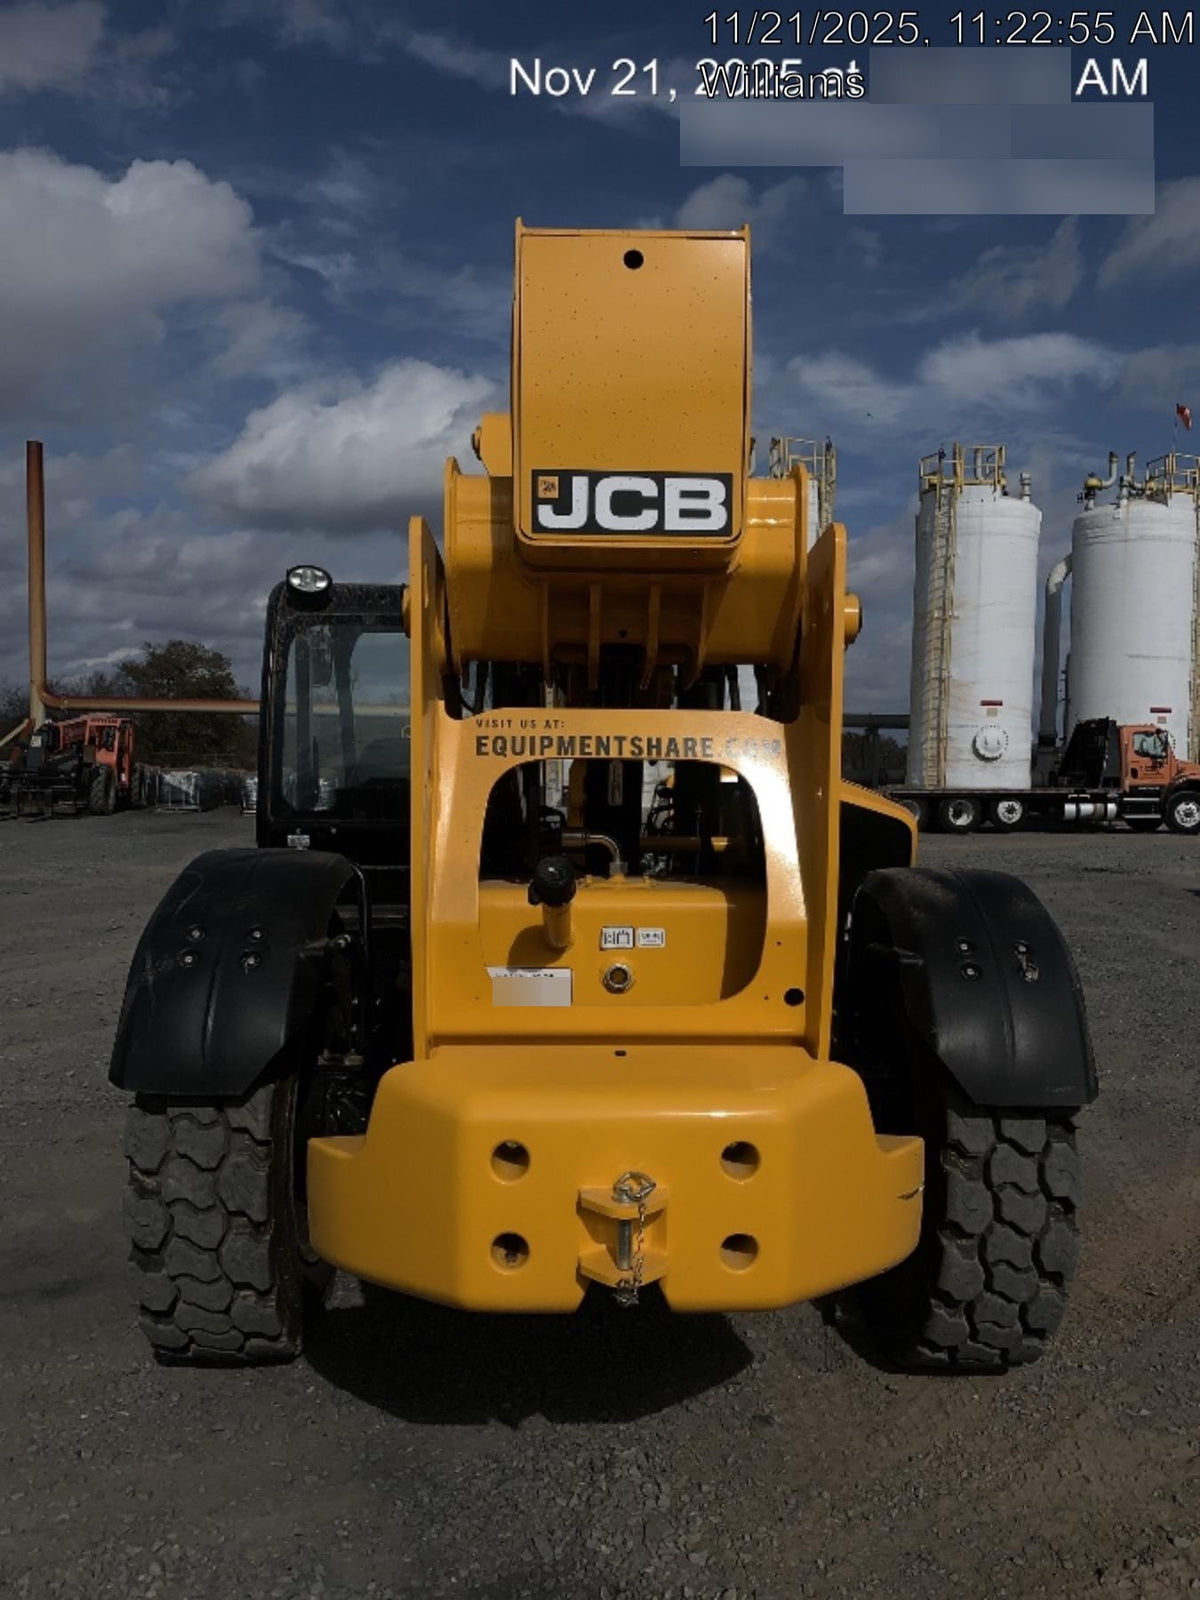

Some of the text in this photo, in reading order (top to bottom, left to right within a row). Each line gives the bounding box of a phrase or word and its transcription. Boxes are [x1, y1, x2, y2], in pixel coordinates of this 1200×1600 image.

[537, 475, 728, 531] JCB
[476, 719, 565, 729] VISIT US AT:
